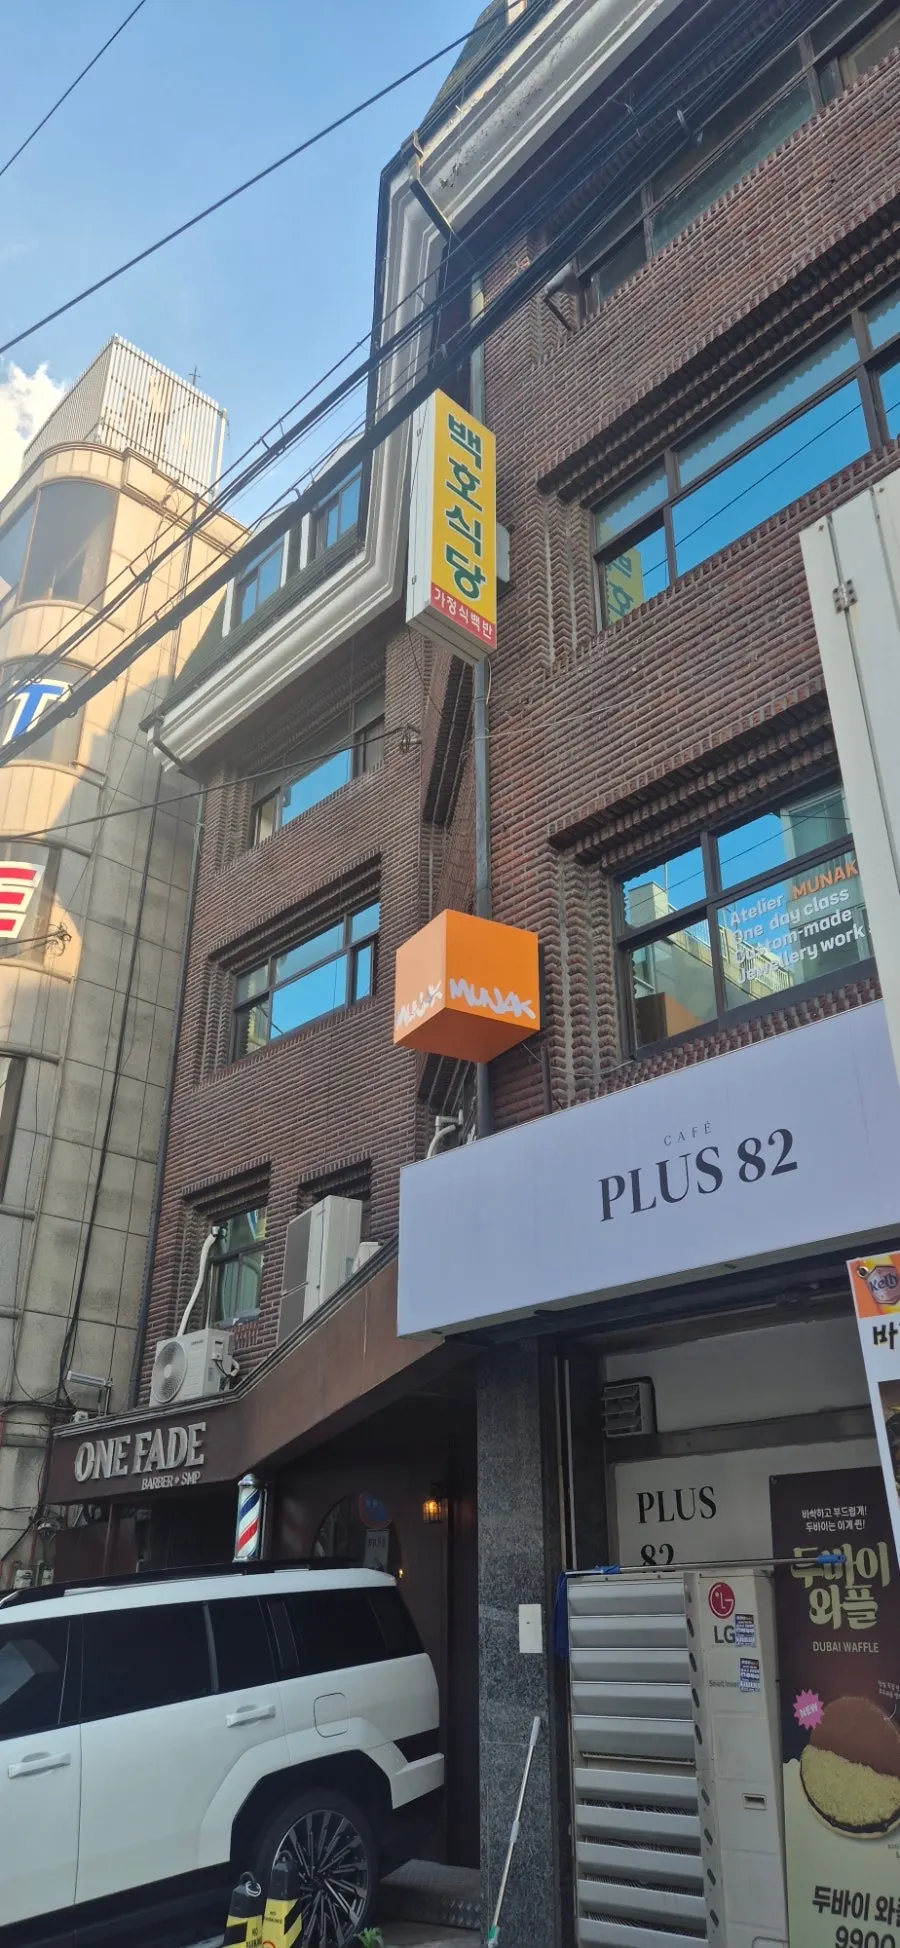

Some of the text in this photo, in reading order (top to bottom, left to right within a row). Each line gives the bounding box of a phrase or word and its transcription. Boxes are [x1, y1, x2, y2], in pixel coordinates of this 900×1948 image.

[445, 413, 487, 600] 백호식당
[434, 588, 492, 640] 가정식백반
[730, 859, 859, 927] Atelier MUNAK
[731, 888, 850, 945] One day class
[449, 978, 536, 1020] MUNAK
[663, 1120, 713, 1147] CAFÉ
[598, 1128, 798, 1222] PLUS 82
[74, 1422, 206, 1482] ONE FADE
[141, 1472, 201, 1490] BARBER SMP
[636, 1486, 717, 1524] PLUS
[805, 1520, 836, 1532] 두바이는
[837, 1519, 853, 1531] 이게
[640, 1543, 676, 1572] 82
[790, 1541, 891, 1588] 두바이
[809, 1584, 879, 1630] 와플
[714, 1625, 735, 1643] LG
[812, 1641, 879, 1653] DUBAI WAFFLE
[800, 1704, 818, 1717] NEW
[812, 1885, 900, 1927] 두바이 와
